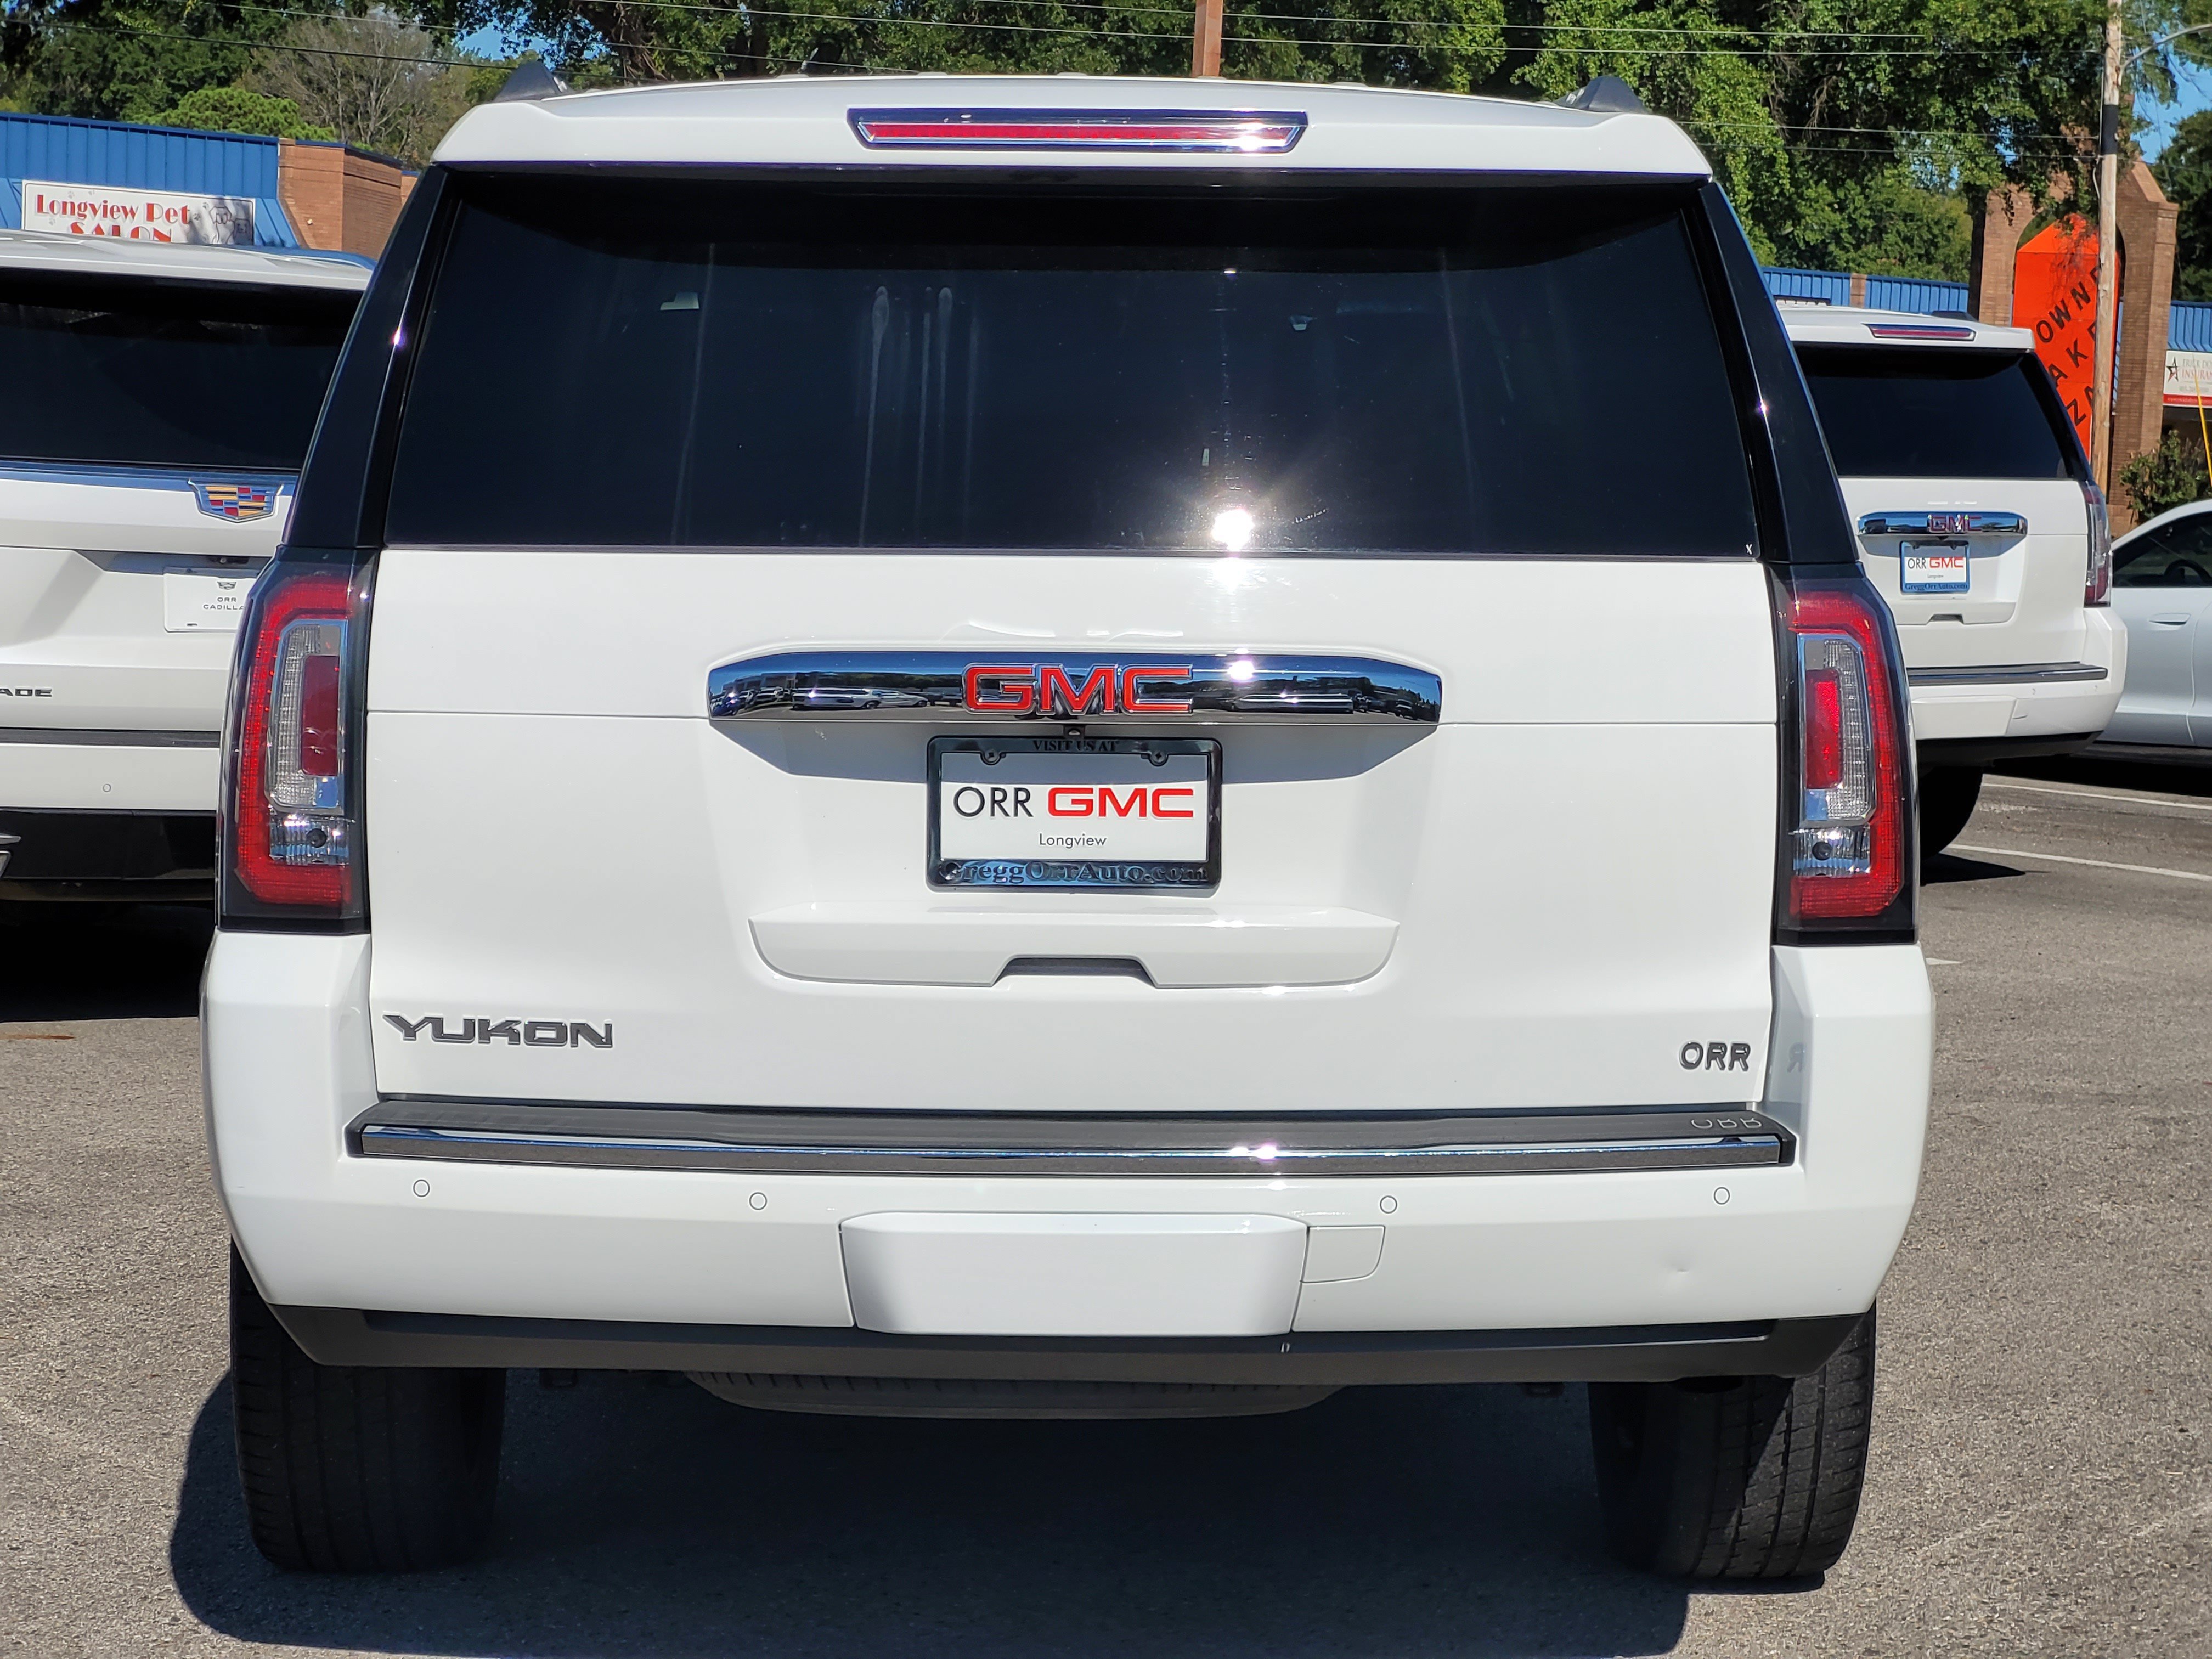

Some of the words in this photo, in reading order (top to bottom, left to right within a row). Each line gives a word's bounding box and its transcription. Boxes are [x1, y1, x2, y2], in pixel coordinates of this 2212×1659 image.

[36, 194, 138, 219] Longview
[145, 202, 190, 225] Pet
[1928, 515, 1982, 533] GMC
[1908, 558, 1927, 569] ORR
[1929, 557, 1963, 568] GMC
[962, 663, 1193, 715] GMC
[1032, 740, 1073, 751] VISIT
[1076, 740, 1096, 752] US
[1099, 741, 1119, 752] AT
[953, 786, 1034, 817] ORR
[1047, 787, 1194, 817] GMC
[1039, 833, 1107, 849] Longview
[382, 1014, 613, 1048] YUKON
[1679, 1042, 1751, 1071] ORR
